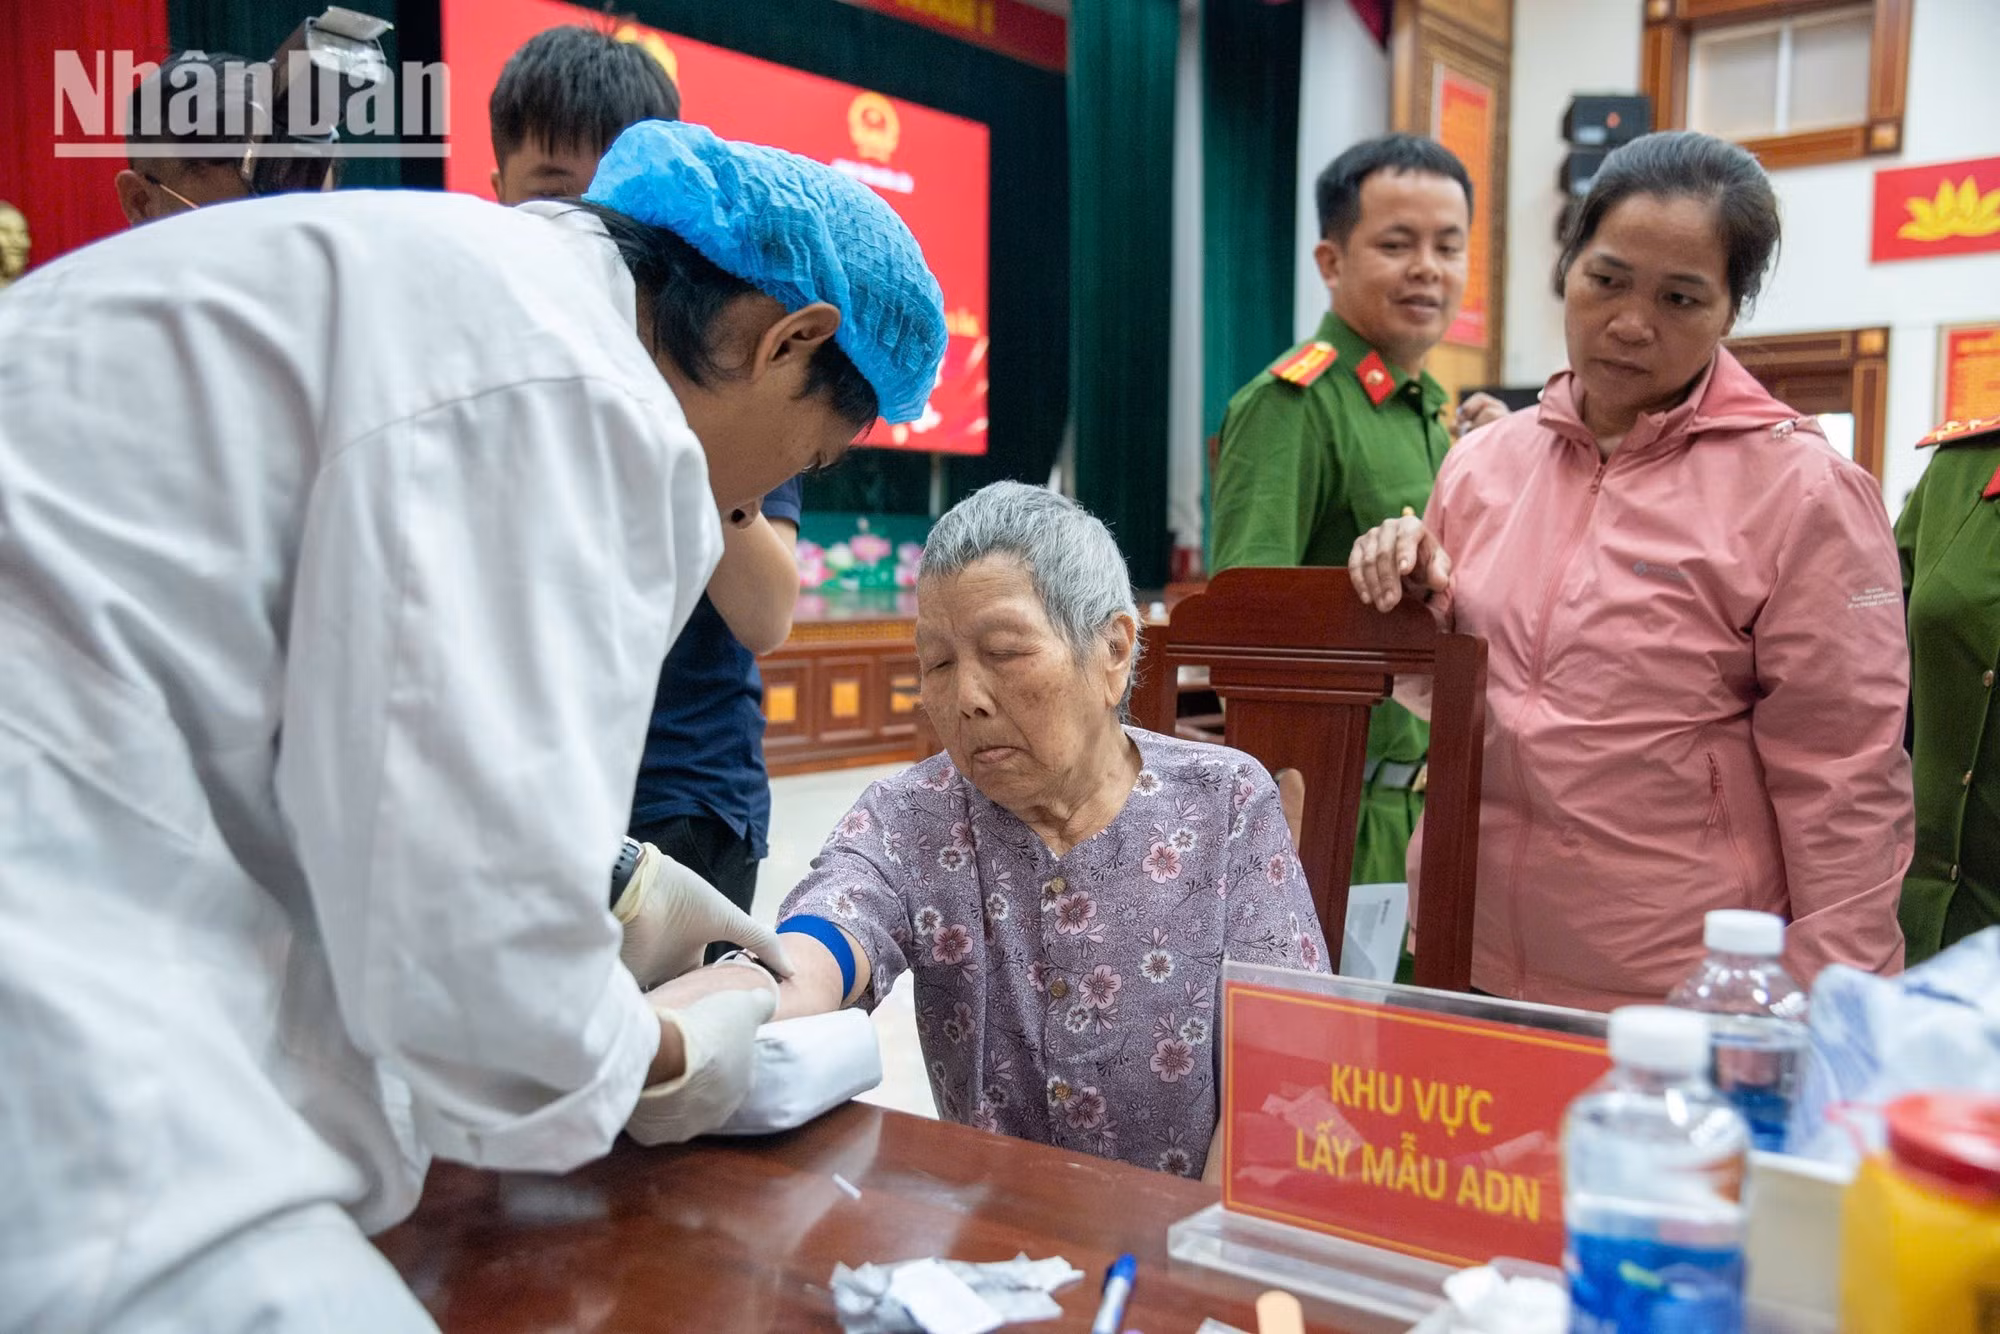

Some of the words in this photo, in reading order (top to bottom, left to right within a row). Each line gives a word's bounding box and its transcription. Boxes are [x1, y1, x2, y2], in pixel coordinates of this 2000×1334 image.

[1332, 1064, 1403, 1115] KHU
[1412, 1079, 1493, 1137] VỰC
[1297, 1121, 1353, 1180] LẤY
[1362, 1132, 1447, 1200] MẪU
[1458, 1166, 1541, 1223] ADN
